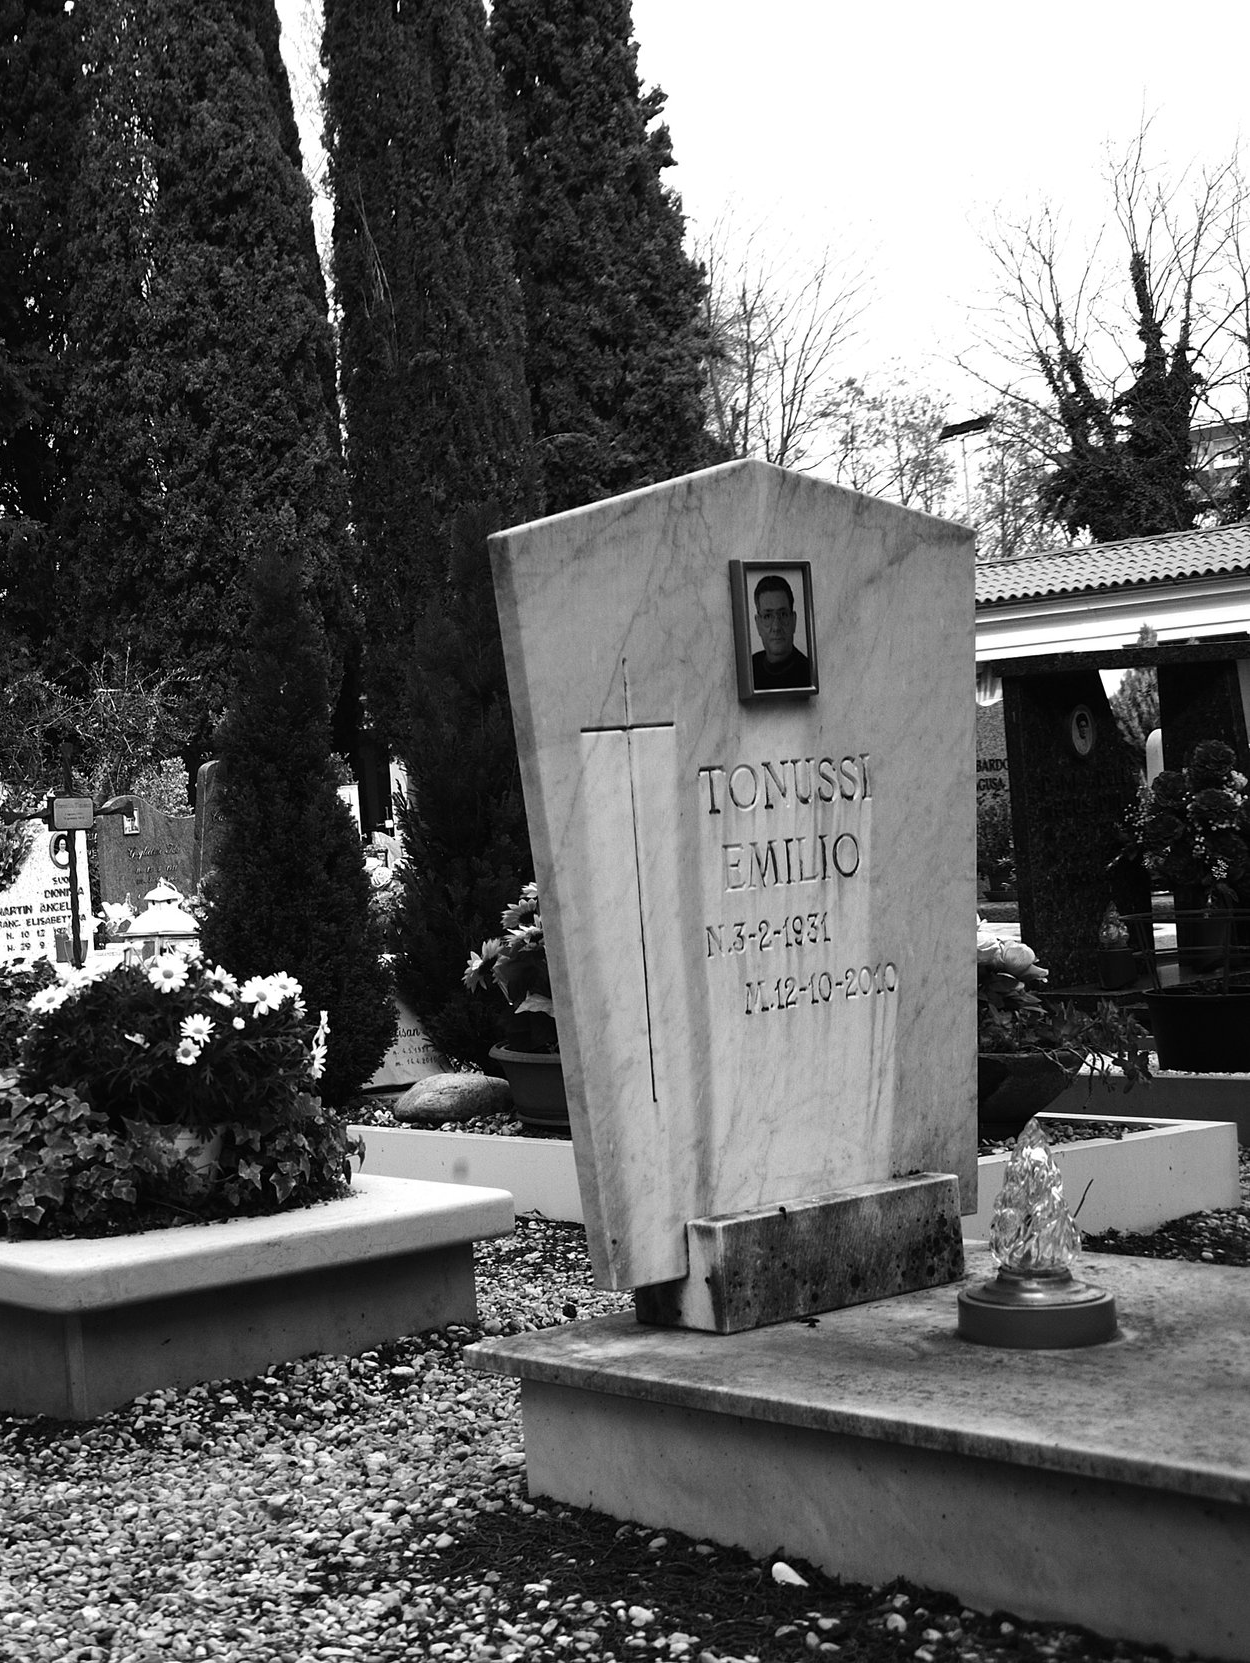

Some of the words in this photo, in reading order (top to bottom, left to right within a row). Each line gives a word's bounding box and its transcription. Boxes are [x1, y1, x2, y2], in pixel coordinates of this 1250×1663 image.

[699, 753, 871, 814] TONUSSI
[977, 778, 1006, 791] GUSA
[722, 833, 859, 892] EMILIO
